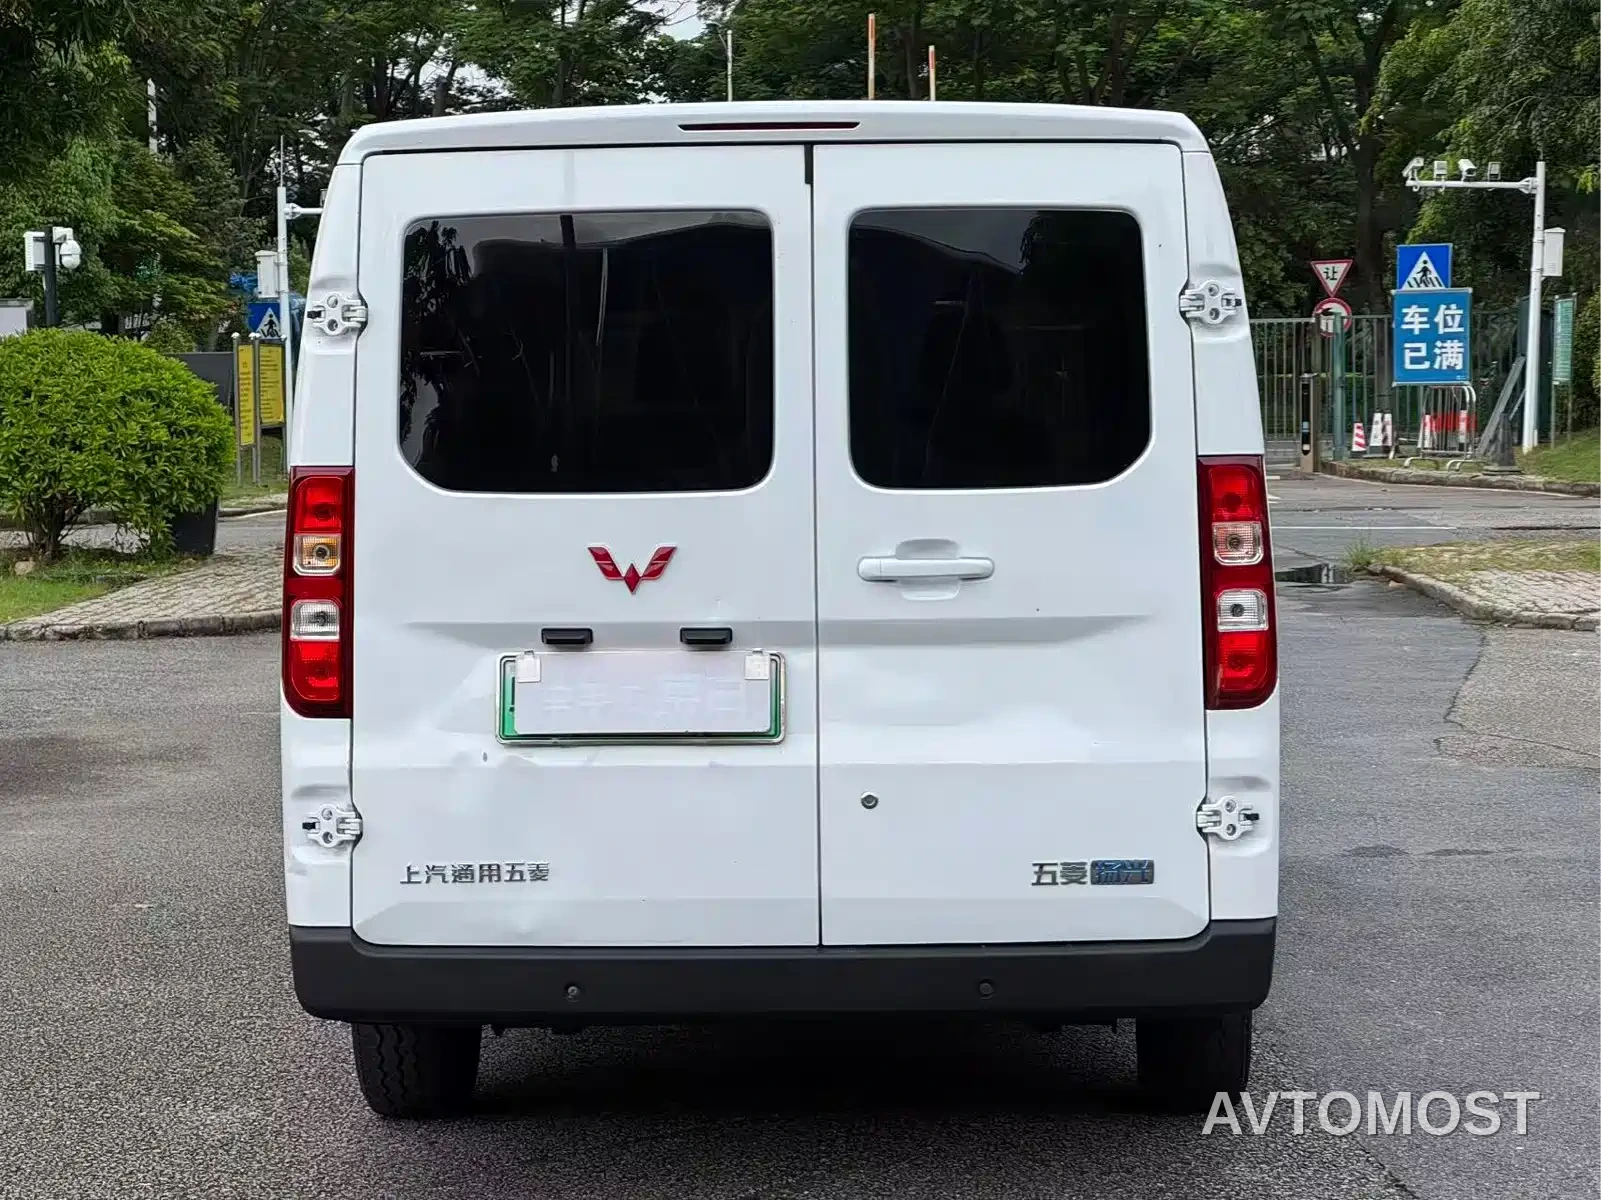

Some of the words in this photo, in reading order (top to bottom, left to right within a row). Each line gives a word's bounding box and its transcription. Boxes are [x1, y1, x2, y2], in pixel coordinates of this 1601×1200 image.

[1323, 266, 1339, 282] 让
[1401, 304, 1465, 335] 车位
[1403, 340, 1465, 371] 已满
[400, 861, 550, 885] 上汽通用五菱
